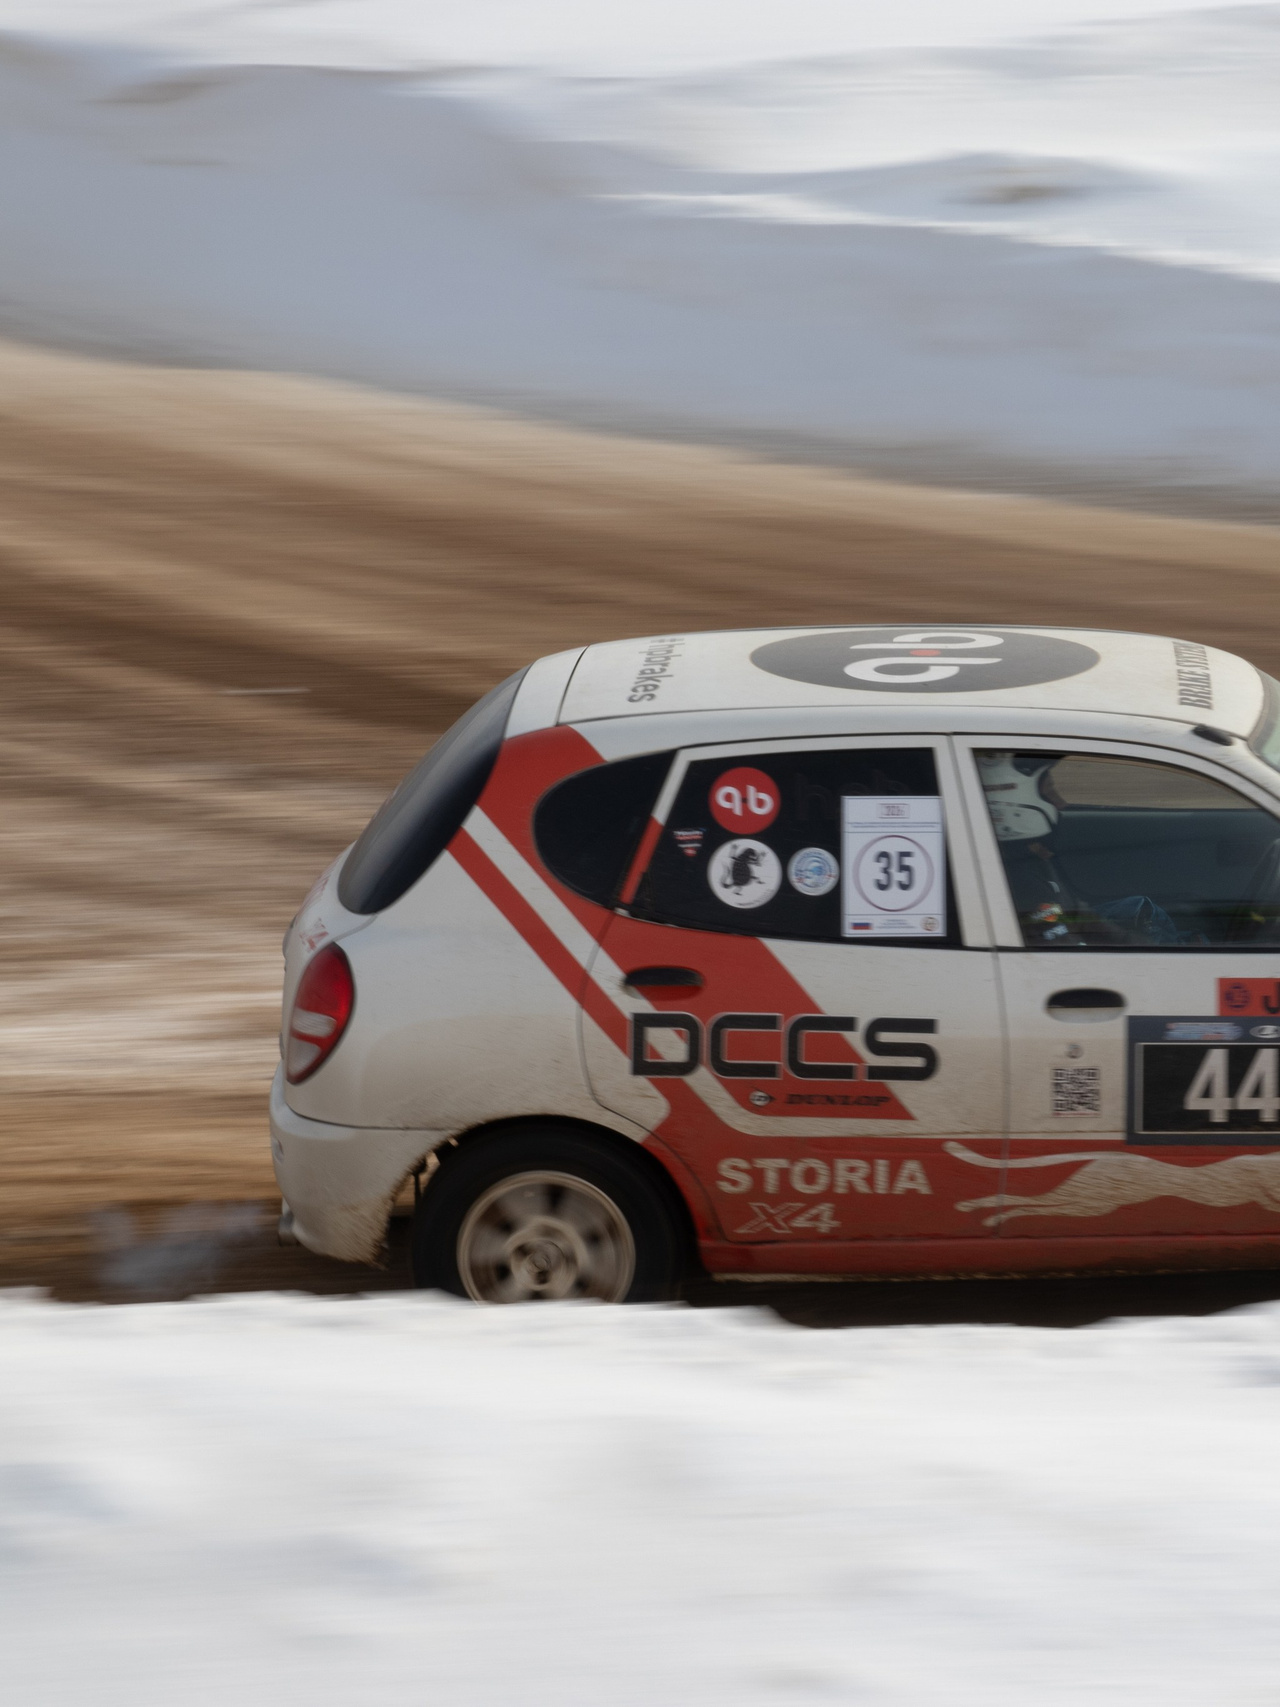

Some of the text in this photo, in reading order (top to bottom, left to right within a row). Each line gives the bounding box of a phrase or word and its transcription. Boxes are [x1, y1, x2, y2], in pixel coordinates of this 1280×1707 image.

[1177, 670, 1214, 710] BRAKE
[874, 851, 914, 891] 35
[631, 1012, 939, 1081] DCCS
[785, 1093, 891, 1106] DUNLOP
[716, 1157, 933, 1194] STORIA
[733, 1202, 842, 1234] X4
